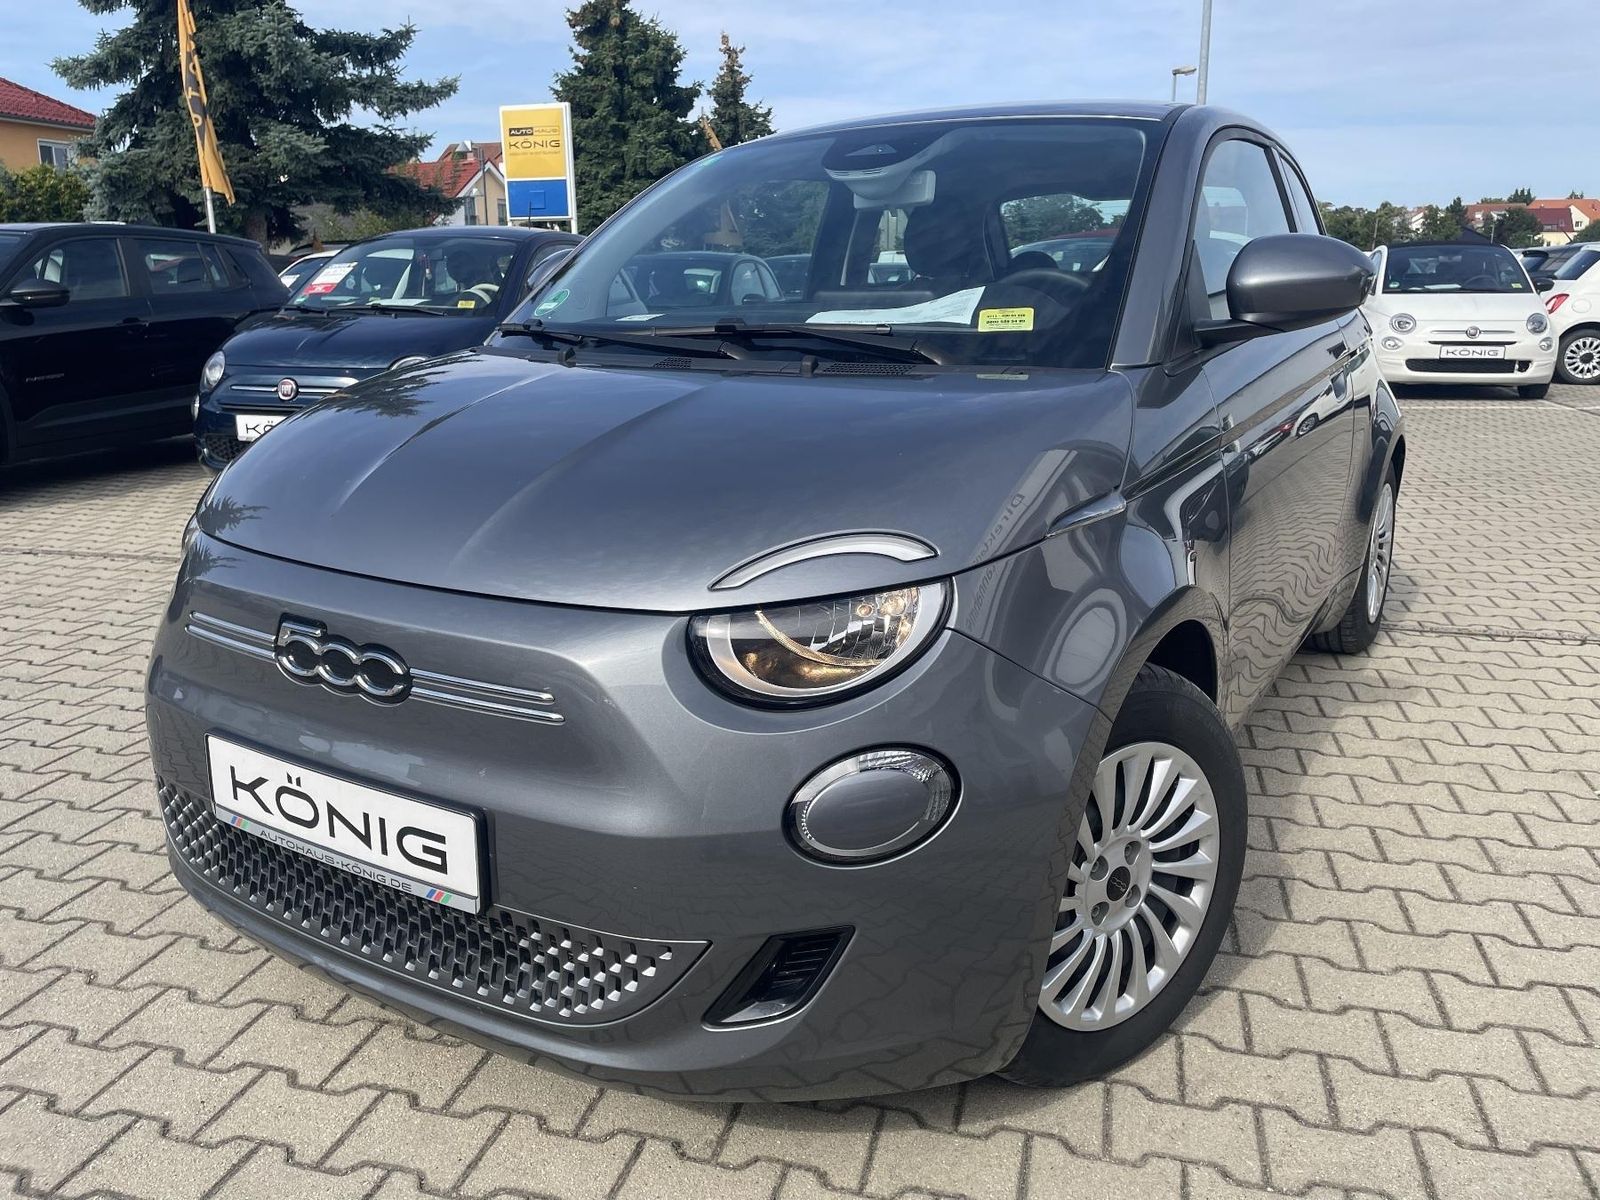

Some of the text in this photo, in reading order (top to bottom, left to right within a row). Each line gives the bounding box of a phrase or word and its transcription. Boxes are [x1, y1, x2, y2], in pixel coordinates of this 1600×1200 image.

[509, 138, 560, 150] KÖNIG
[1446, 348, 1500, 357] KÖNIG
[277, 622, 408, 696] 500
[229, 765, 448, 875] KÖNIG
[259, 829, 412, 893] AUTOHAUS-KÖNIG.DE
